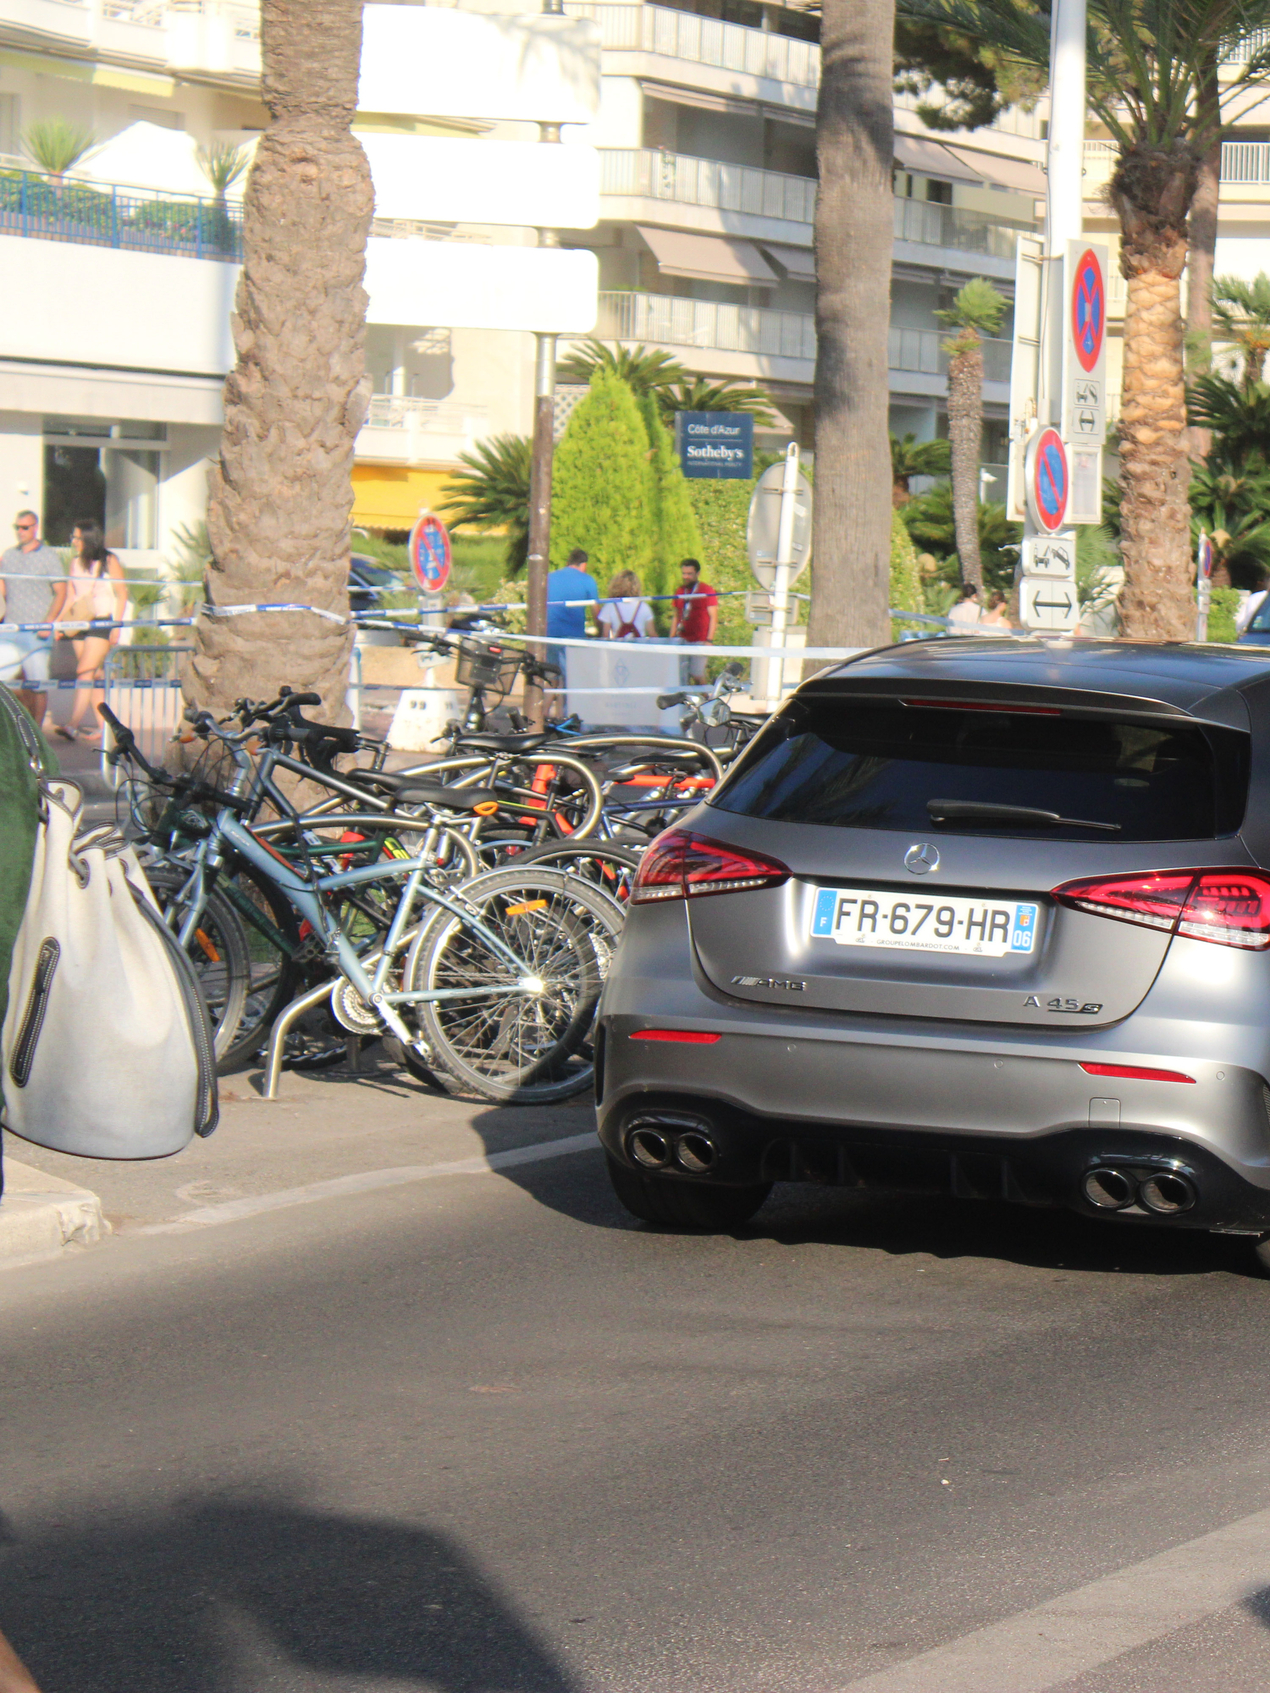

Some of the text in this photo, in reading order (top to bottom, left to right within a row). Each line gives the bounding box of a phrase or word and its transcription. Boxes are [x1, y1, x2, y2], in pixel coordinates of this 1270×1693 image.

[687, 423, 741, 435] Côte d'Azur
[687, 445, 744, 461] Sotheby's
[835, 897, 1011, 944] FR-679-HR
[1012, 928, 1033, 948] 06
[876, 938, 960, 952] GROUPELOMBARDOT.COM
[757, 978, 807, 992] AMG
[1022, 995, 1041, 1008] A
